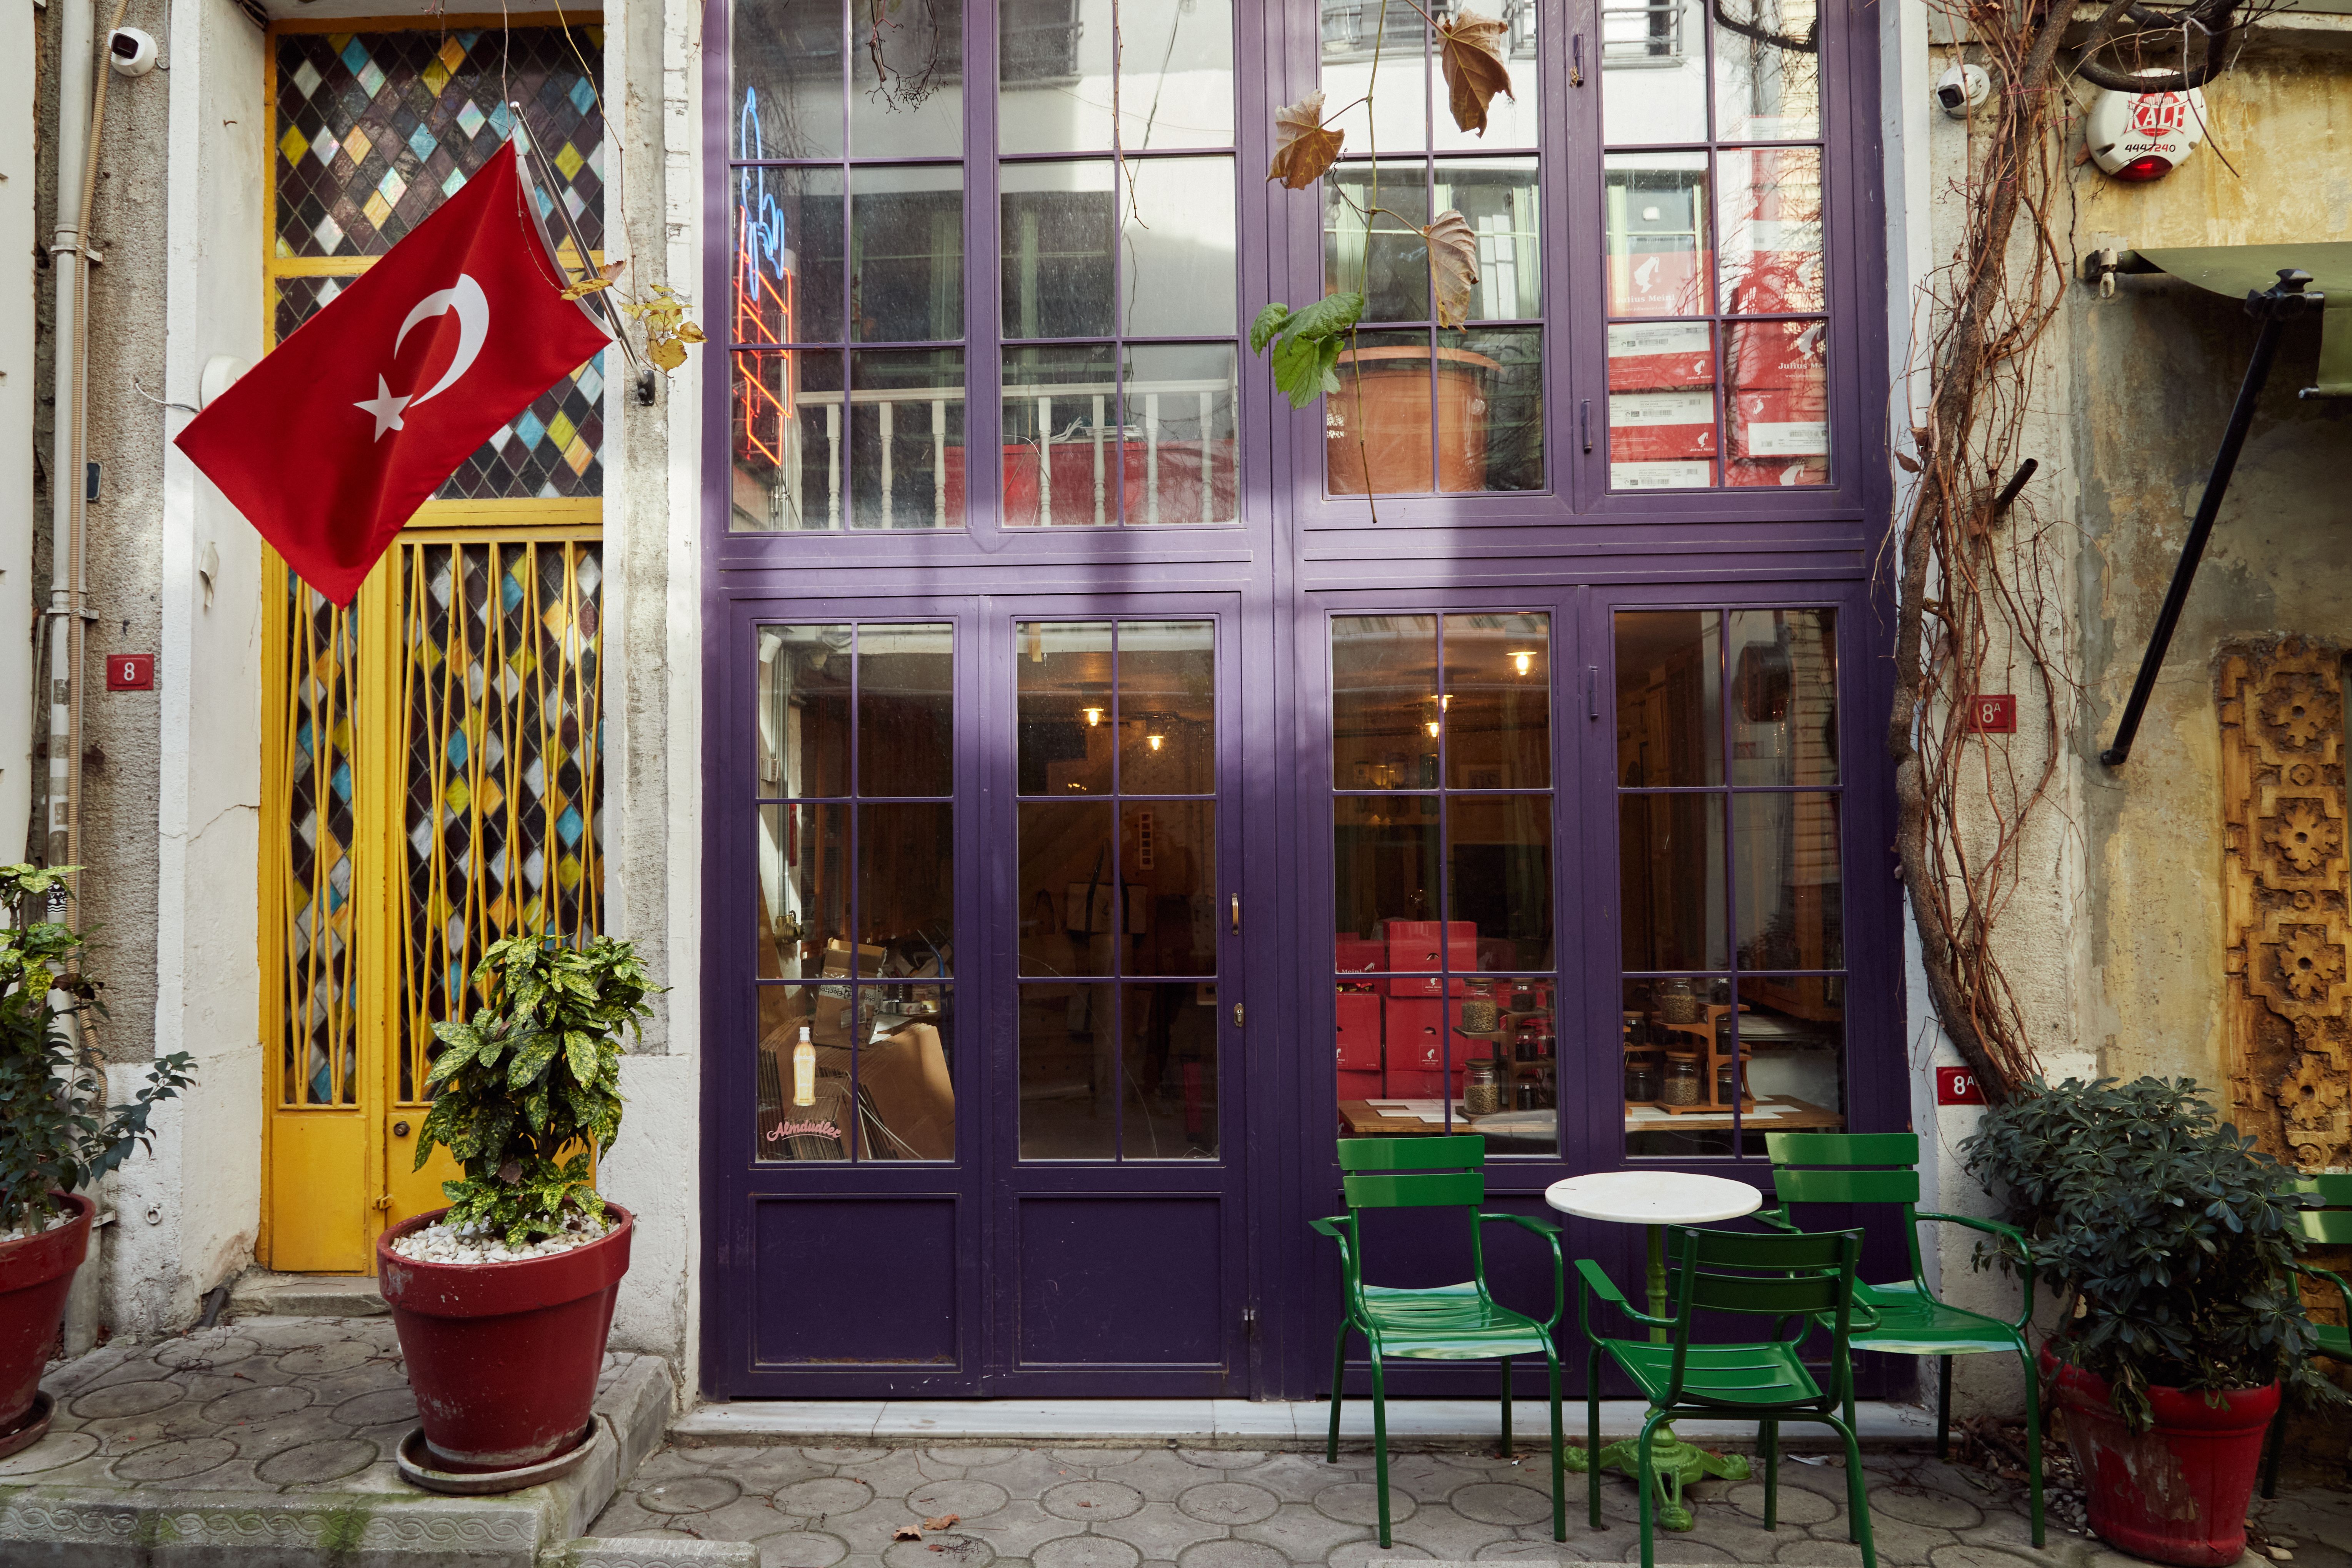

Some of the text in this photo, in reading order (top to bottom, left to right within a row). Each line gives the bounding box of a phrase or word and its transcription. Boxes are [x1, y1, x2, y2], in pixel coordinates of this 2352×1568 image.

[2125, 102, 2185, 132] KALE
[2125, 144, 2175, 152] 4447240
[123, 662, 135, 682] 8
[766, 1119, 842, 1141] Almdudler
